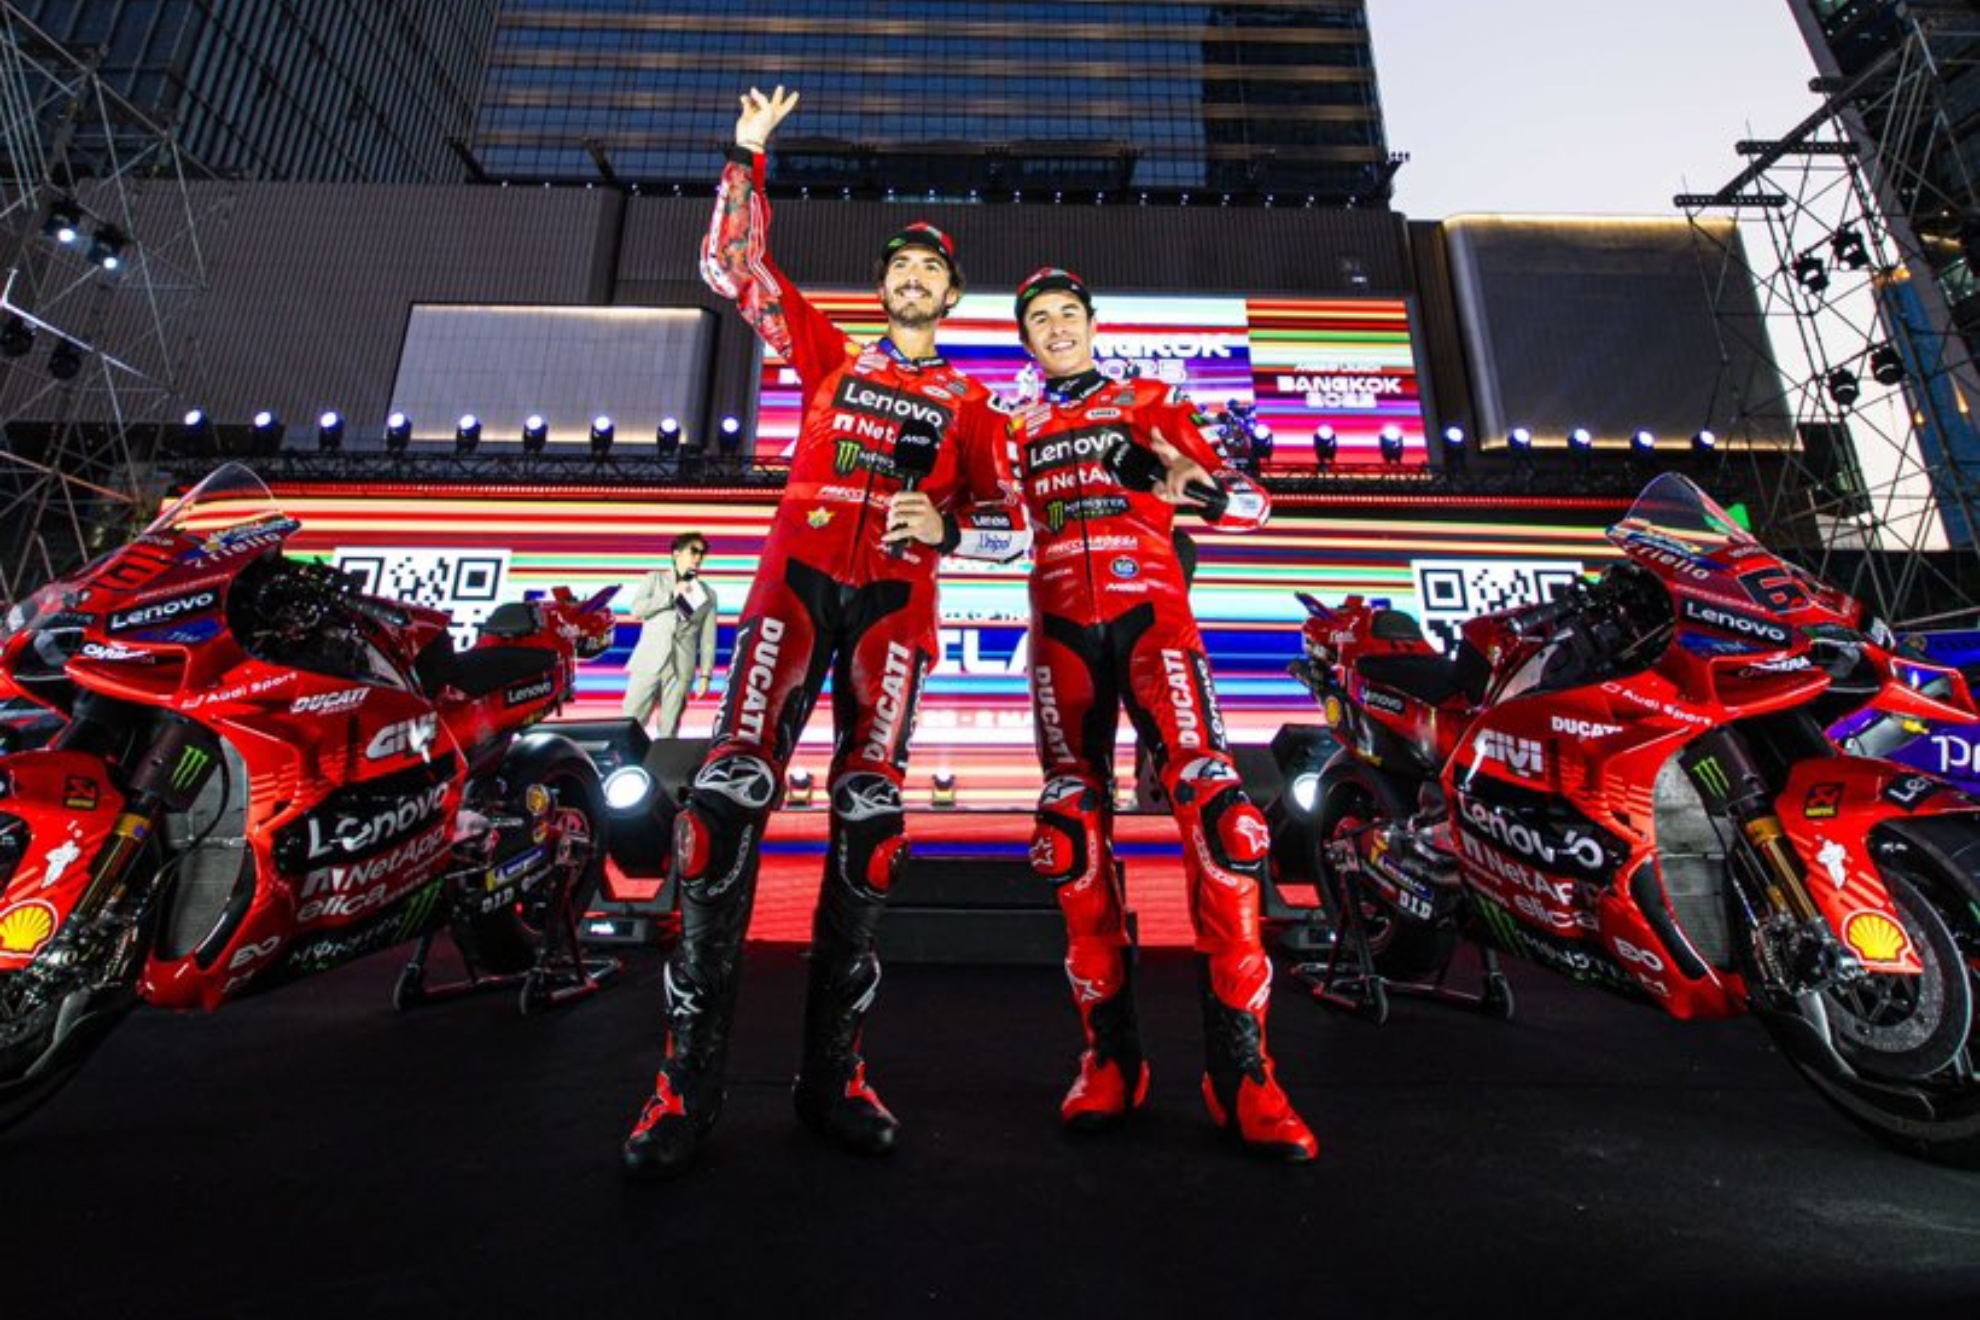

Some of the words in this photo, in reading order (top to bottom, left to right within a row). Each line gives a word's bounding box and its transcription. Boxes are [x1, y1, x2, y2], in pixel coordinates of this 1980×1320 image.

[844, 382, 943, 429] Lenovo
[1277, 376, 1402, 394] BANGKOK
[1052, 466, 1113, 492] NetA
[110, 592, 214, 630] Lenovo
[1686, 601, 1786, 642] Lenovo
[290, 686, 371, 714] DUCATI
[738, 616, 785, 744] DUCATI
[862, 641, 911, 762] DUCATI
[1161, 648, 1200, 749] DUCATI
[1036, 665, 1076, 764] DUCATI
[1473, 728, 1544, 772] GIVI
[309, 782, 449, 859] Lenovo
[1457, 791, 1604, 869] Lenovo
